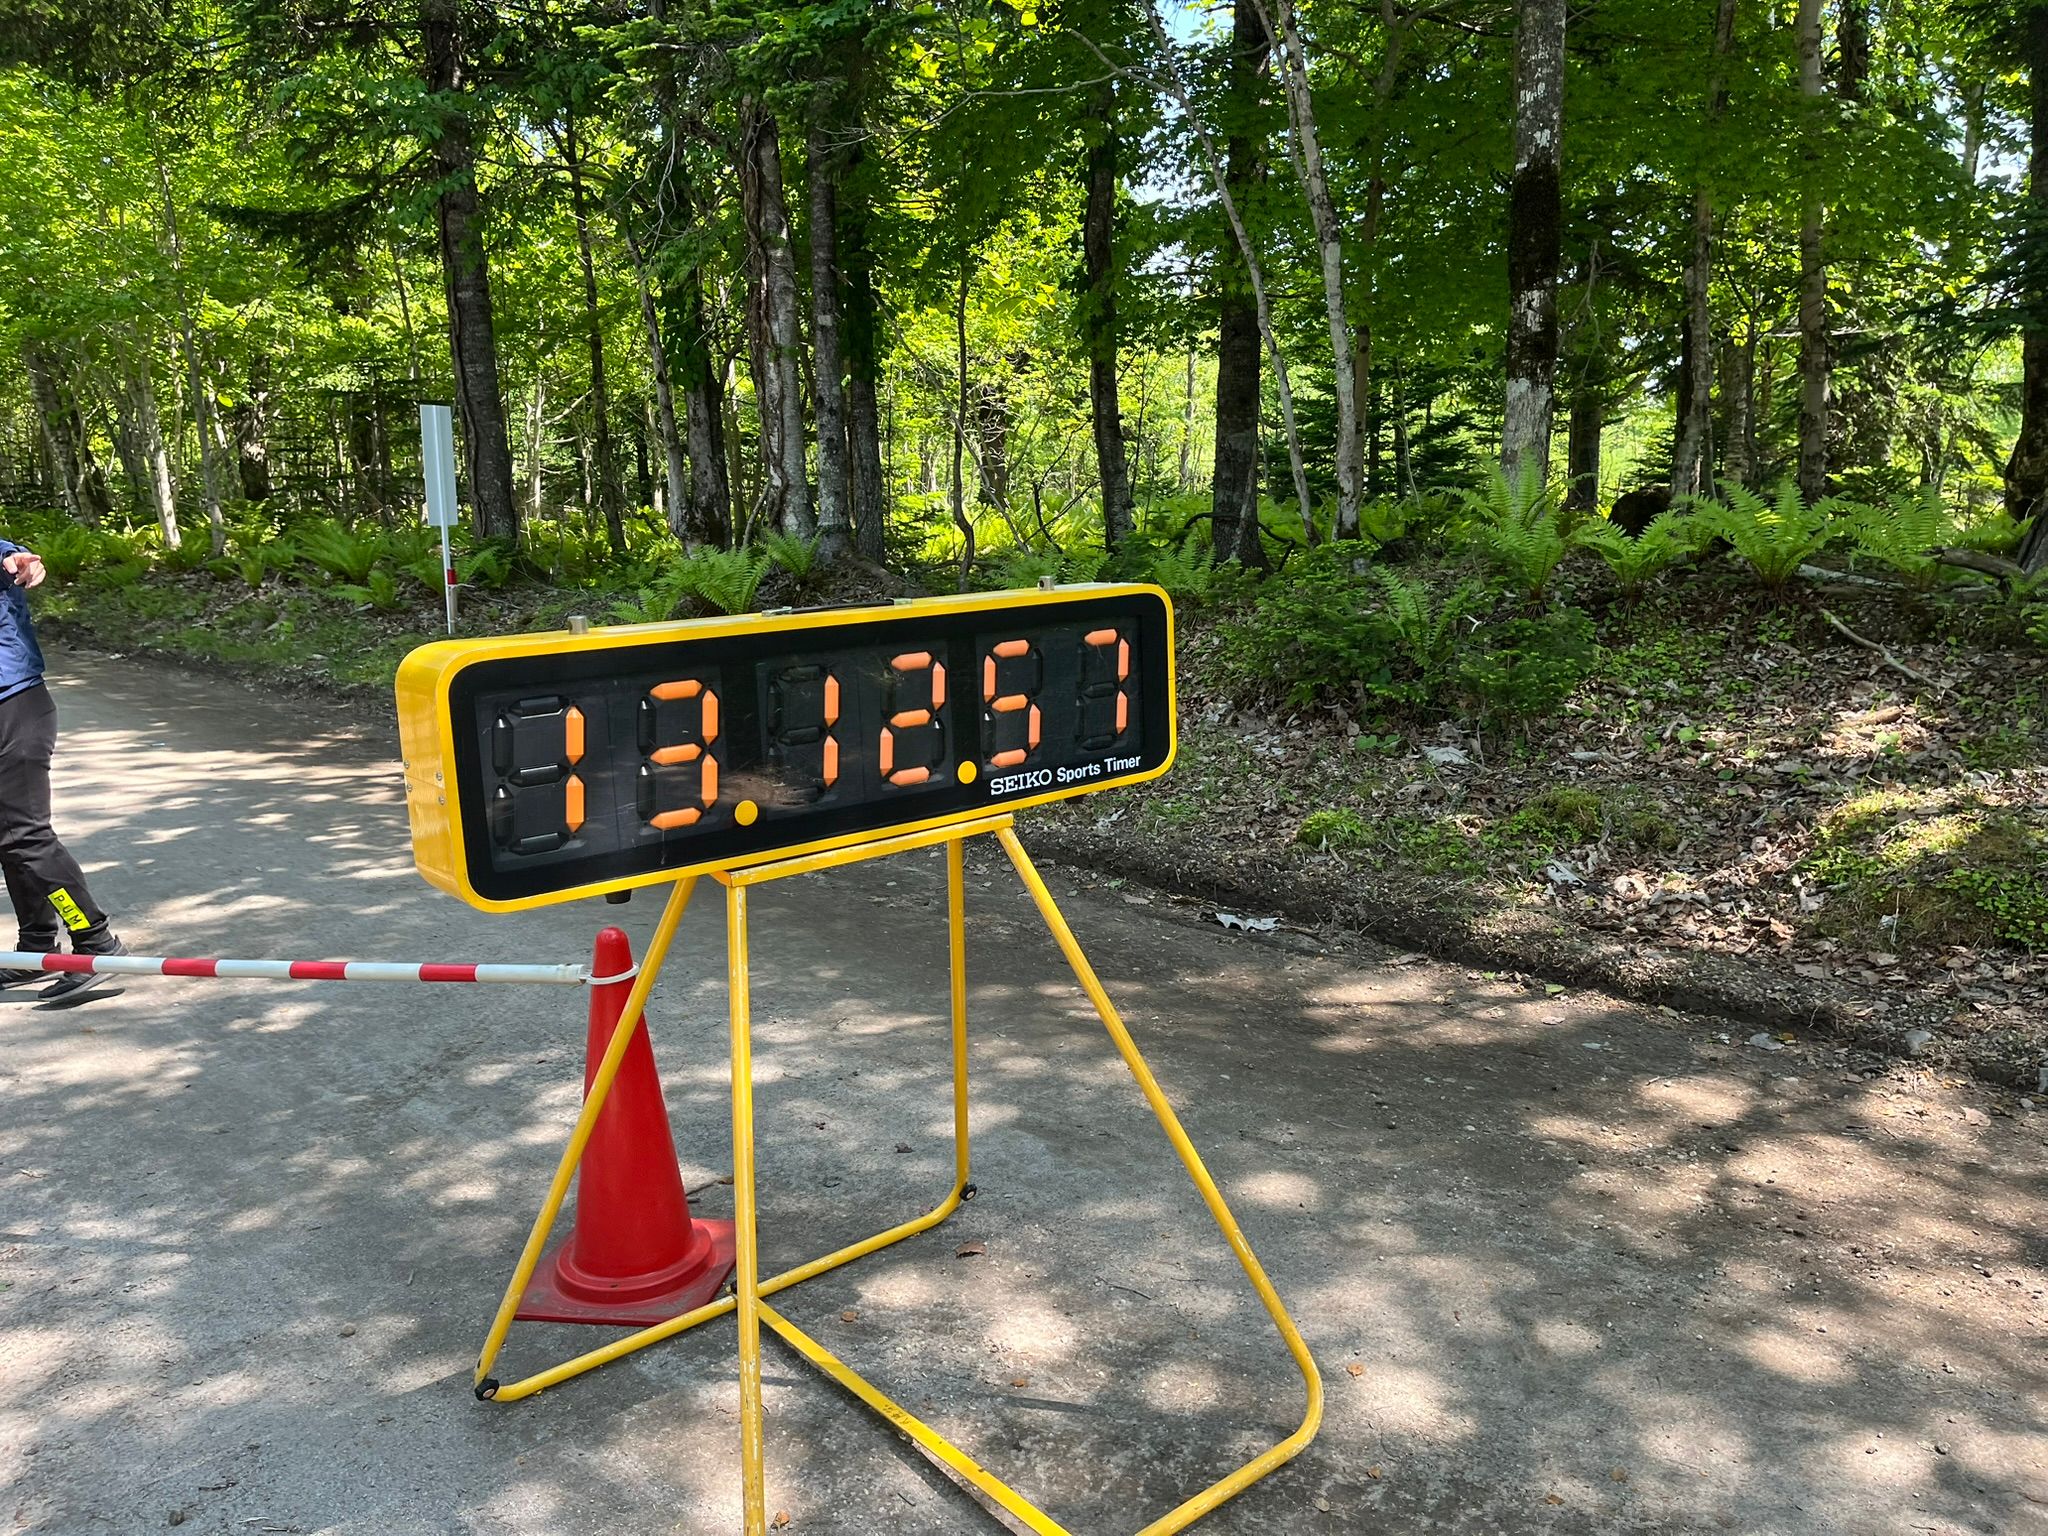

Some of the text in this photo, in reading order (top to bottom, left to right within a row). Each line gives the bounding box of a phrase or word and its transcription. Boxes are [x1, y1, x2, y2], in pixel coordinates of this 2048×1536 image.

[990, 755, 1142, 796] SEIKO Sports Timer
